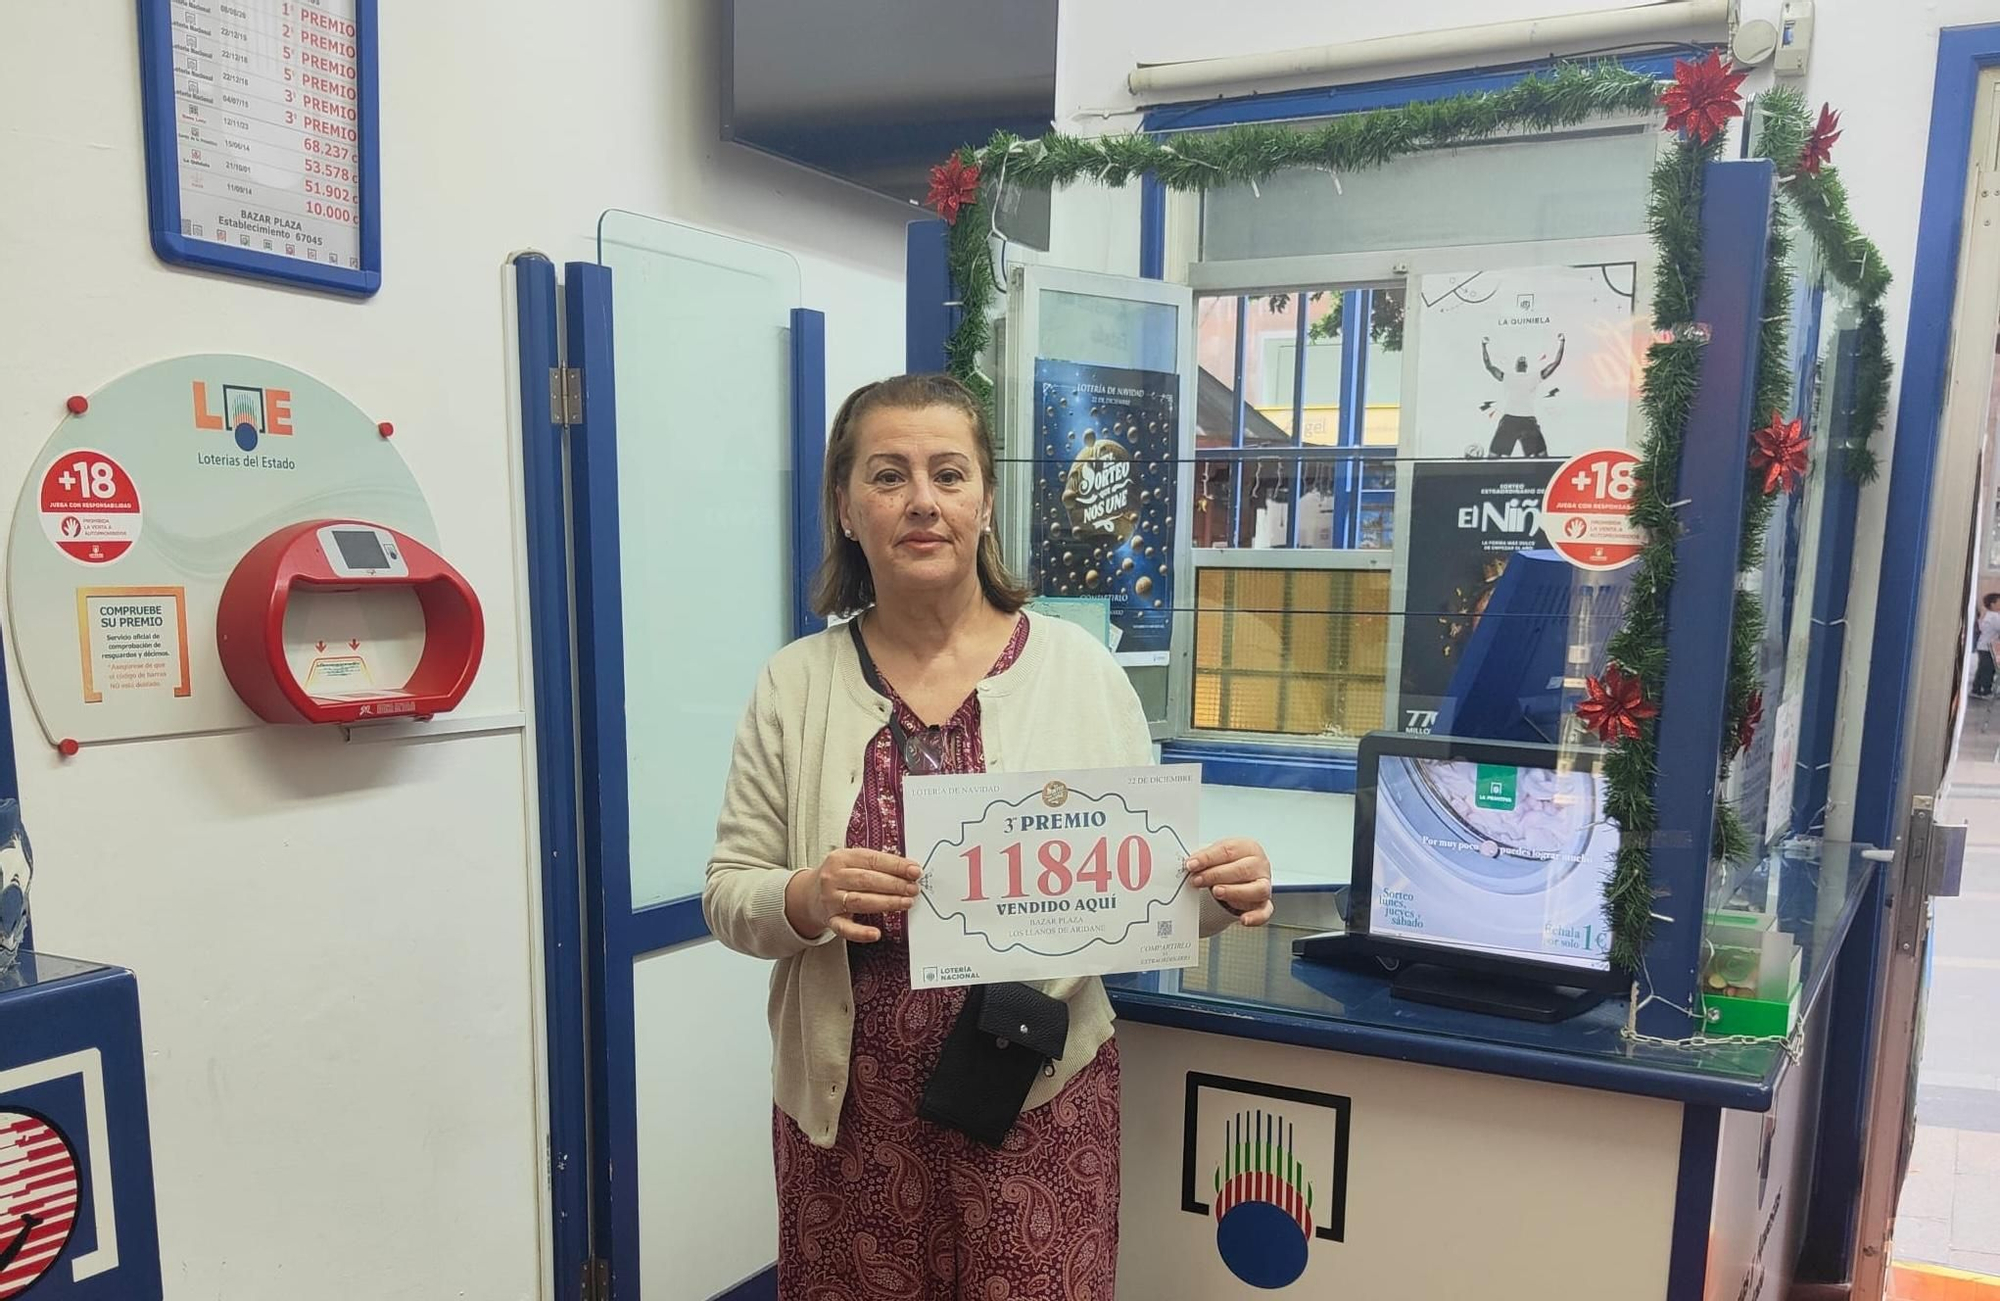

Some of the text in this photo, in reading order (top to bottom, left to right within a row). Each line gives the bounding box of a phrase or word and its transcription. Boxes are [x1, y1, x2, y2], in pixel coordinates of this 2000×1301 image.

[301, 8, 355, 38] PREMIO
[301, 30, 356, 59] PREMIO
[302, 52, 356, 80] PREMIO
[302, 73, 356, 101] PREMIO
[303, 94, 356, 122] PREMIO
[304, 115, 357, 142] PREMIO
[304, 138, 350, 160] 68.237
[304, 158, 350, 182] 53.578
[304, 179, 350, 203] 51.902
[240, 209, 303, 232] BAZAR PLAZA
[306, 201, 350, 223] 10.000
[218, 216, 324, 246] Establecimiento 67045
[1510, 316, 1550, 326] QUINIELA
[1077, 383, 1145, 398] LOTERÍA DE NAVIDAD
[244, 455, 259, 468] del
[262, 456, 296, 470] Estado
[58, 461, 116, 499] +18
[1079, 459, 1130, 495] SORTEO
[1571, 461, 1636, 500] +18
[82, 502, 132, 510] RESPONSABILIDAD
[1083, 489, 1128, 524] NOS UNE
[1458, 498, 1541, 537] El Niñ
[100, 606, 162, 616] COMPRUEBE
[101, 616, 163, 628] SU PREMIO
[102, 651, 138, 660] resguardos
[1405, 727, 1432, 735] MILLO
[1128, 775, 1192, 786] 22 DE DICIEMBRE
[912, 785, 1000, 797] LOTERÍA DE NAVIDAD
[1020, 811, 1106, 832] PREMIO
[1422, 836, 1480, 851] Por muy poco
[1500, 846, 1531, 857] puedes
[1532, 849, 1560, 862] lograr
[959, 834, 1152, 902] 11840
[1380, 894, 1407, 909] lunes,
[1383, 887, 1414, 901] Sorteo
[996, 894, 1117, 916] VENDIDO AQUÍ
[1030, 916, 1084, 926] BAZAR PLAZA
[1392, 915, 1424, 928] sábado
[1009, 930, 1024, 938] LOS
[1026, 927, 1056, 936] LLANOS
[1070, 924, 1106, 934] ARIDANE
[1560, 938, 1579, 948] solo
[940, 966, 972, 974] LOTERÍA
[940, 973, 980, 981] NACIONAL
